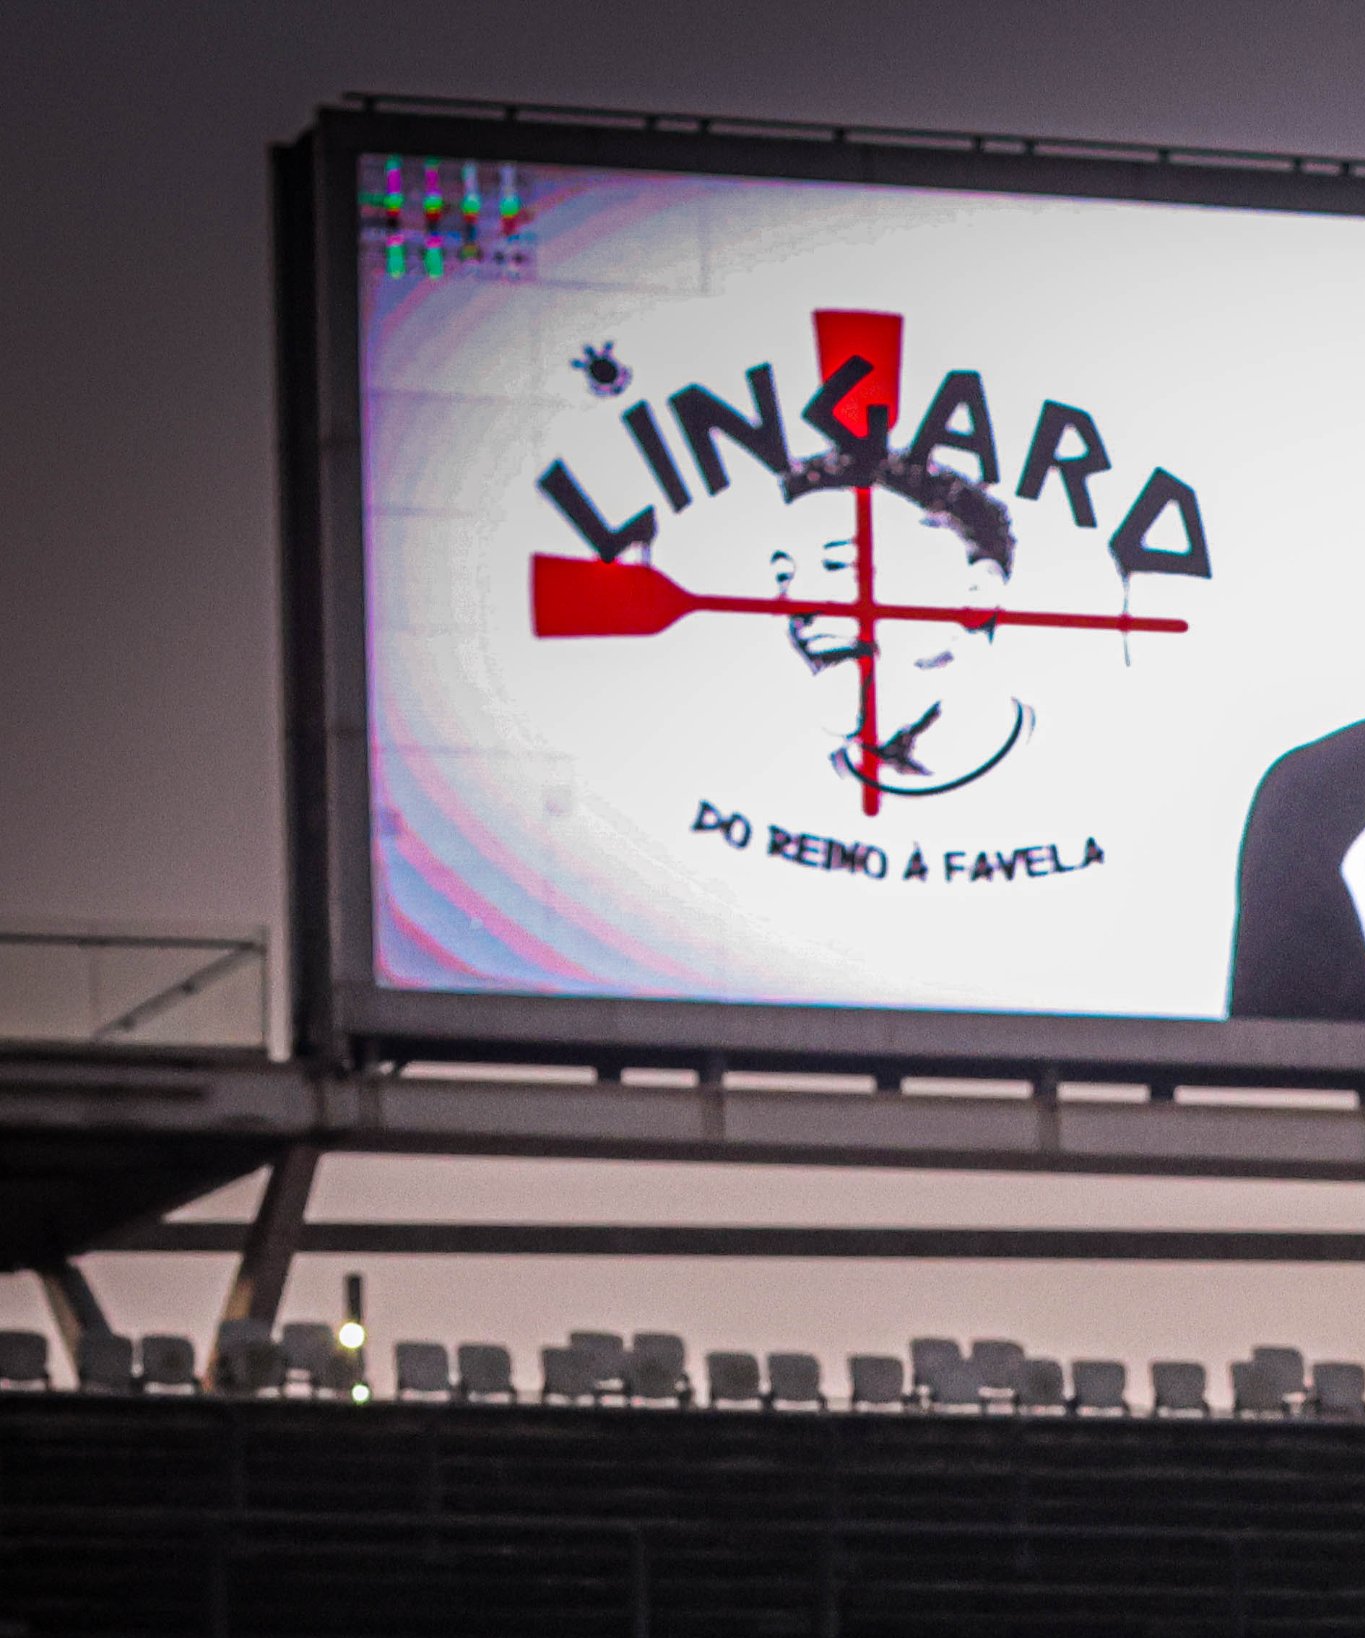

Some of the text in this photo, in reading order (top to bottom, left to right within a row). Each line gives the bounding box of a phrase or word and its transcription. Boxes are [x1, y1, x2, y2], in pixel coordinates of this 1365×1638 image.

[536, 354, 1212, 579] LINGARD
[692, 800, 752, 849] DO
[944, 837, 1105, 882] FAVELA
